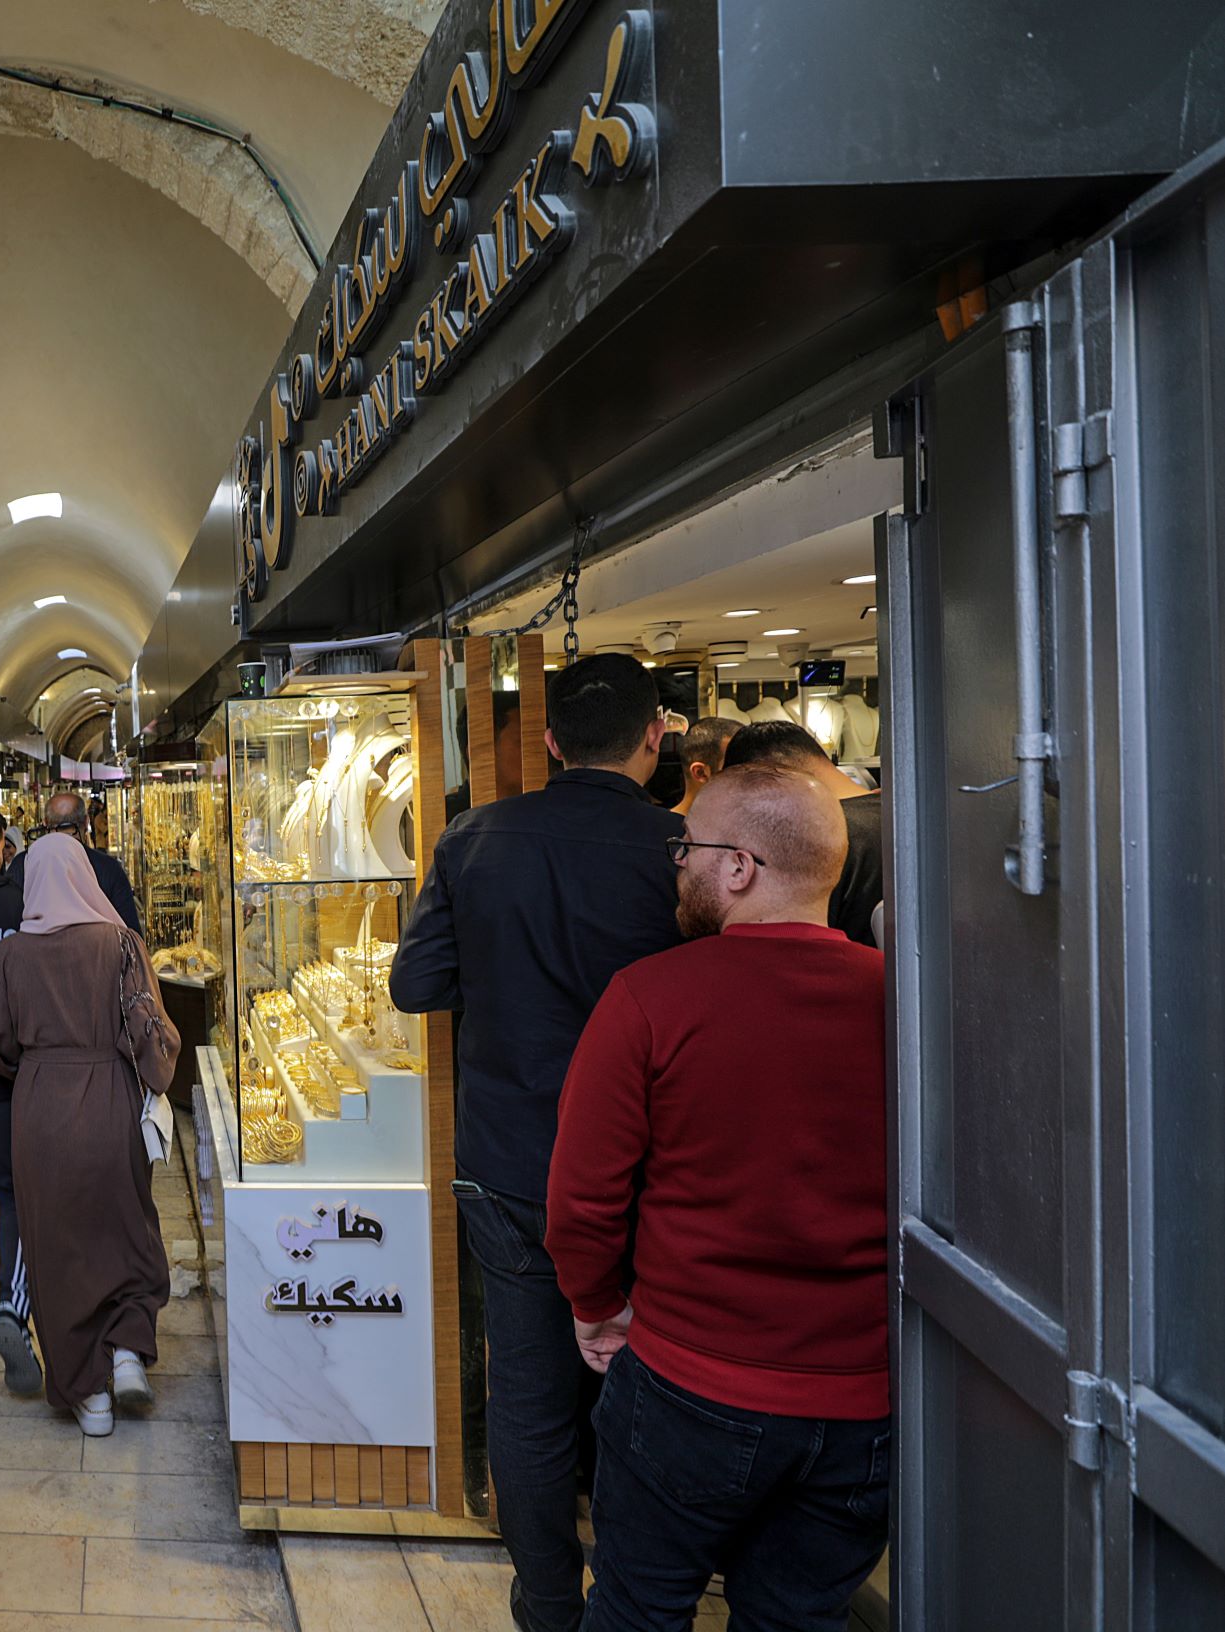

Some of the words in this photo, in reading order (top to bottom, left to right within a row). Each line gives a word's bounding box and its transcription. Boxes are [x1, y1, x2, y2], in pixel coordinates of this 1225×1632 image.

[335, 343, 410, 488] HANI
[412, 135, 566, 392] SKAIK
[276, 1201, 387, 1261] هاني
[262, 1276, 405, 1326] سكيك
